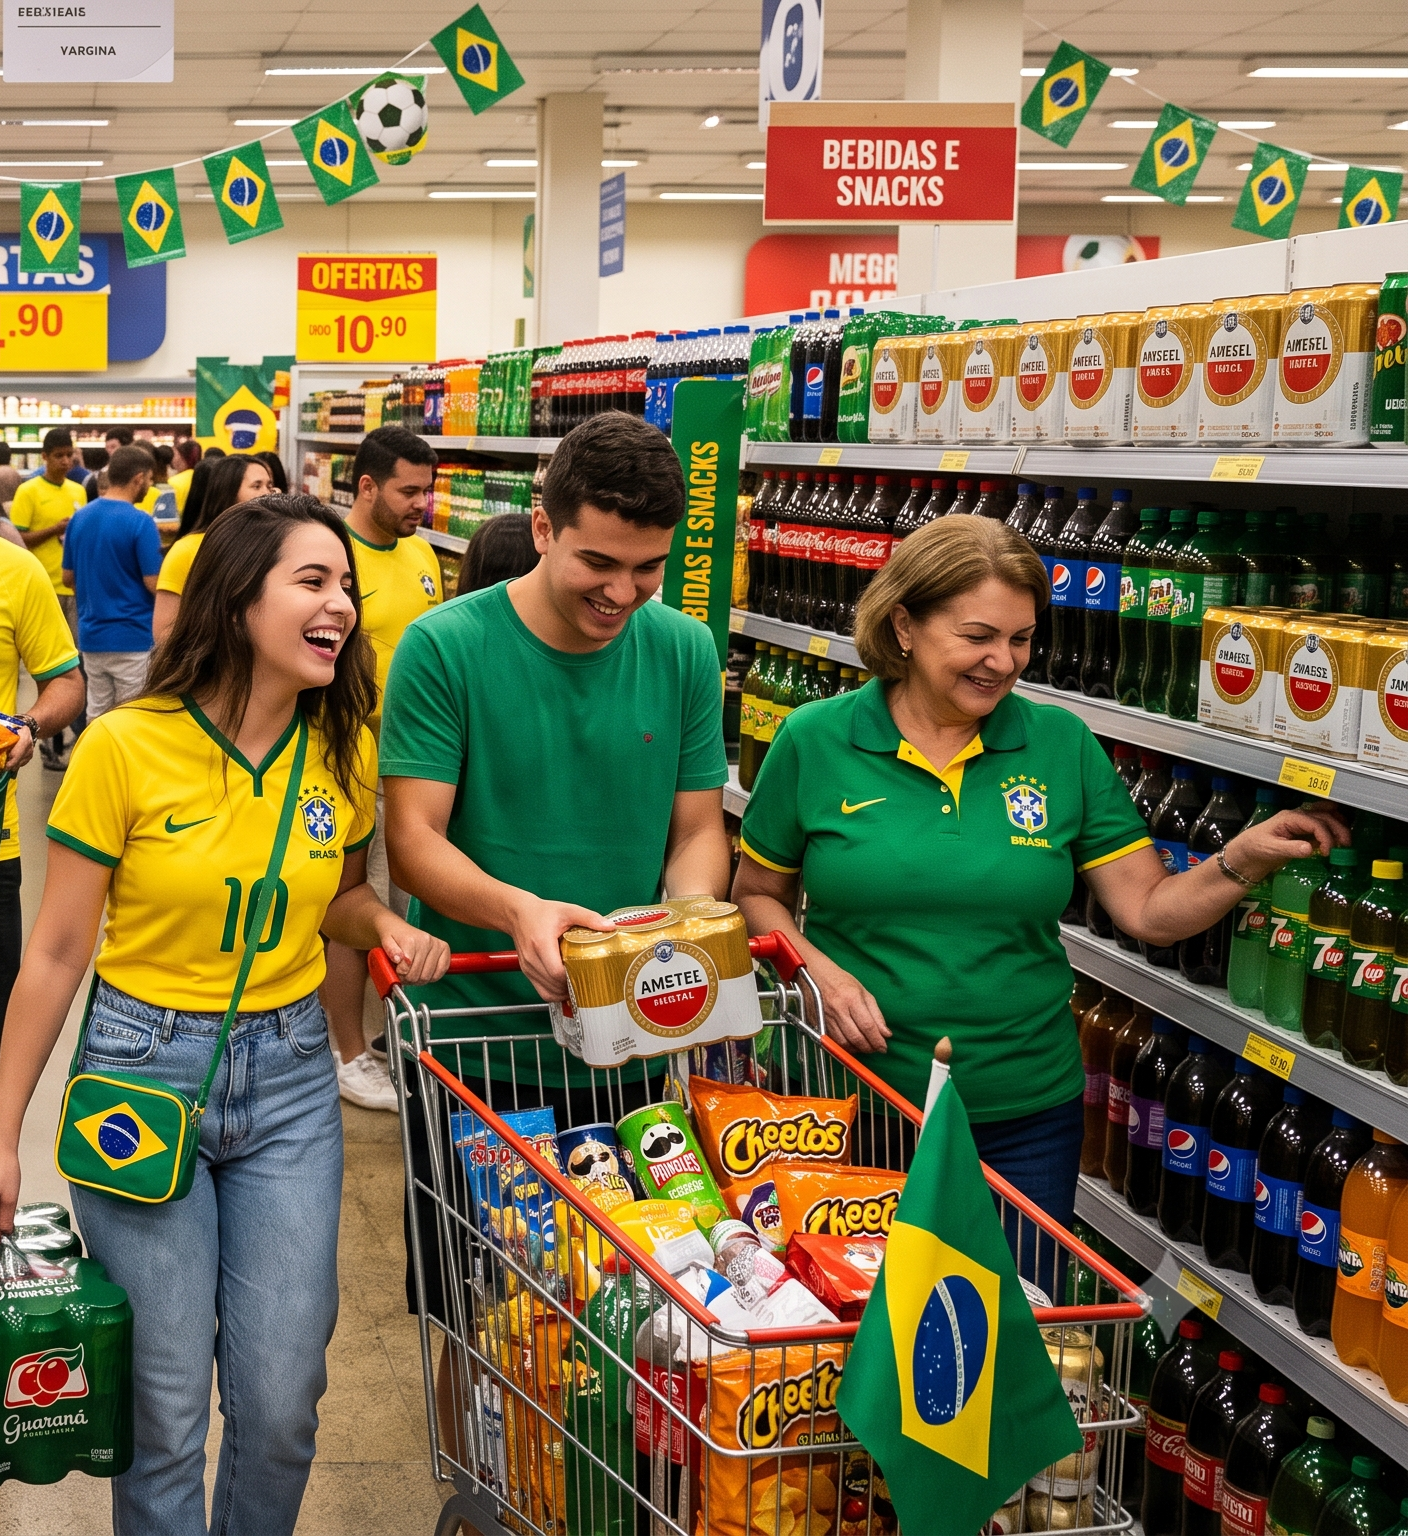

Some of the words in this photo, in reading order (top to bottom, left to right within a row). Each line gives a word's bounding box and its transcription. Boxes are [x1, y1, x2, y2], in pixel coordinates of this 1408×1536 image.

[823, 139, 937, 170] BEBIDAS
[945, 140, 960, 170] E
[836, 176, 944, 206] SNACKS
[311, 262, 423, 290] OFERTAS
[687, 440, 720, 531] SNACKS
[686, 536, 713, 548] E
[1011, 836, 1052, 848] BRASIL
[220, 877, 289, 953] 10
[722, 1113, 846, 1175] Cheetos
[4, 1409, 89, 1445] Guaraná
